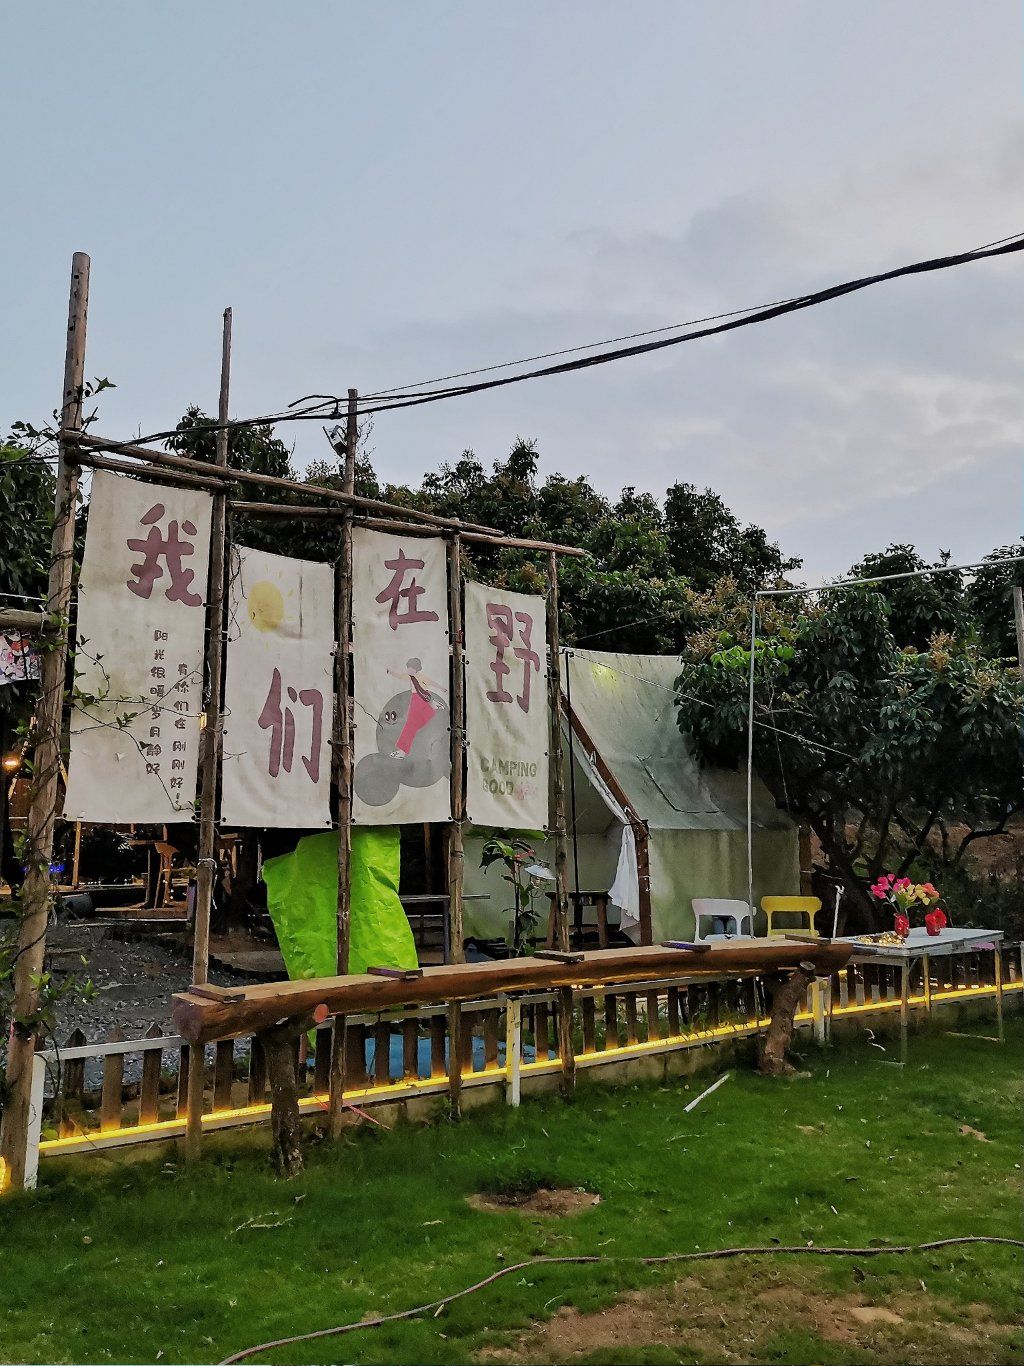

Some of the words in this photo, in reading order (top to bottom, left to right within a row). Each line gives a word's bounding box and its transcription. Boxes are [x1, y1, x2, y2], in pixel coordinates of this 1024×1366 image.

[126, 503, 203, 607] 我
[257, 667, 323, 783] 们
[375, 548, 439, 631] 在
[486, 603, 540, 713] 野
[480, 756, 537, 778] CAMPING
[482, 778, 514, 796] GOOD
